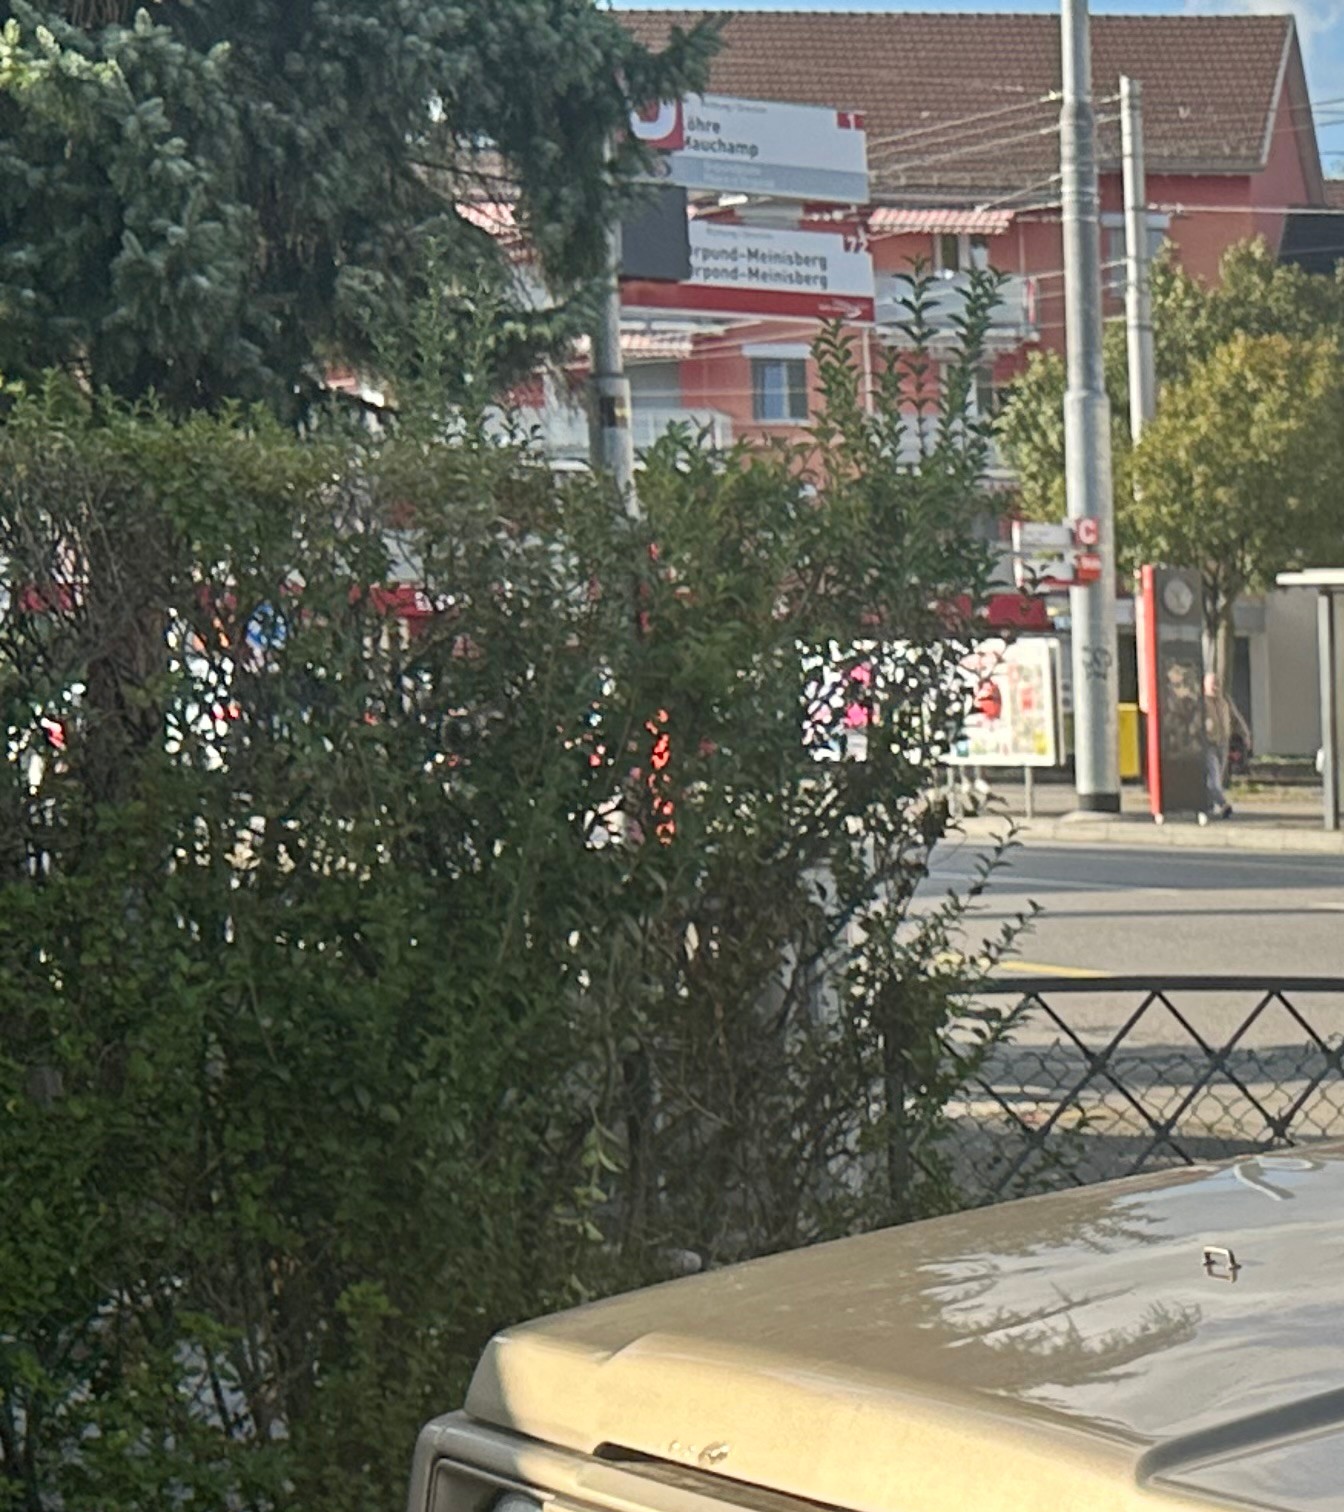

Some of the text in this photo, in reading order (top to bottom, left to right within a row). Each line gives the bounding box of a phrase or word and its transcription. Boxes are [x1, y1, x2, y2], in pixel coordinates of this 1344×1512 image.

[685, 115, 720, 134] öhre
[690, 247, 827, 273] rpund-Meinisberg
[690, 266, 827, 290] rpond-Meinisberg
[1079, 518, 1098, 544] C
